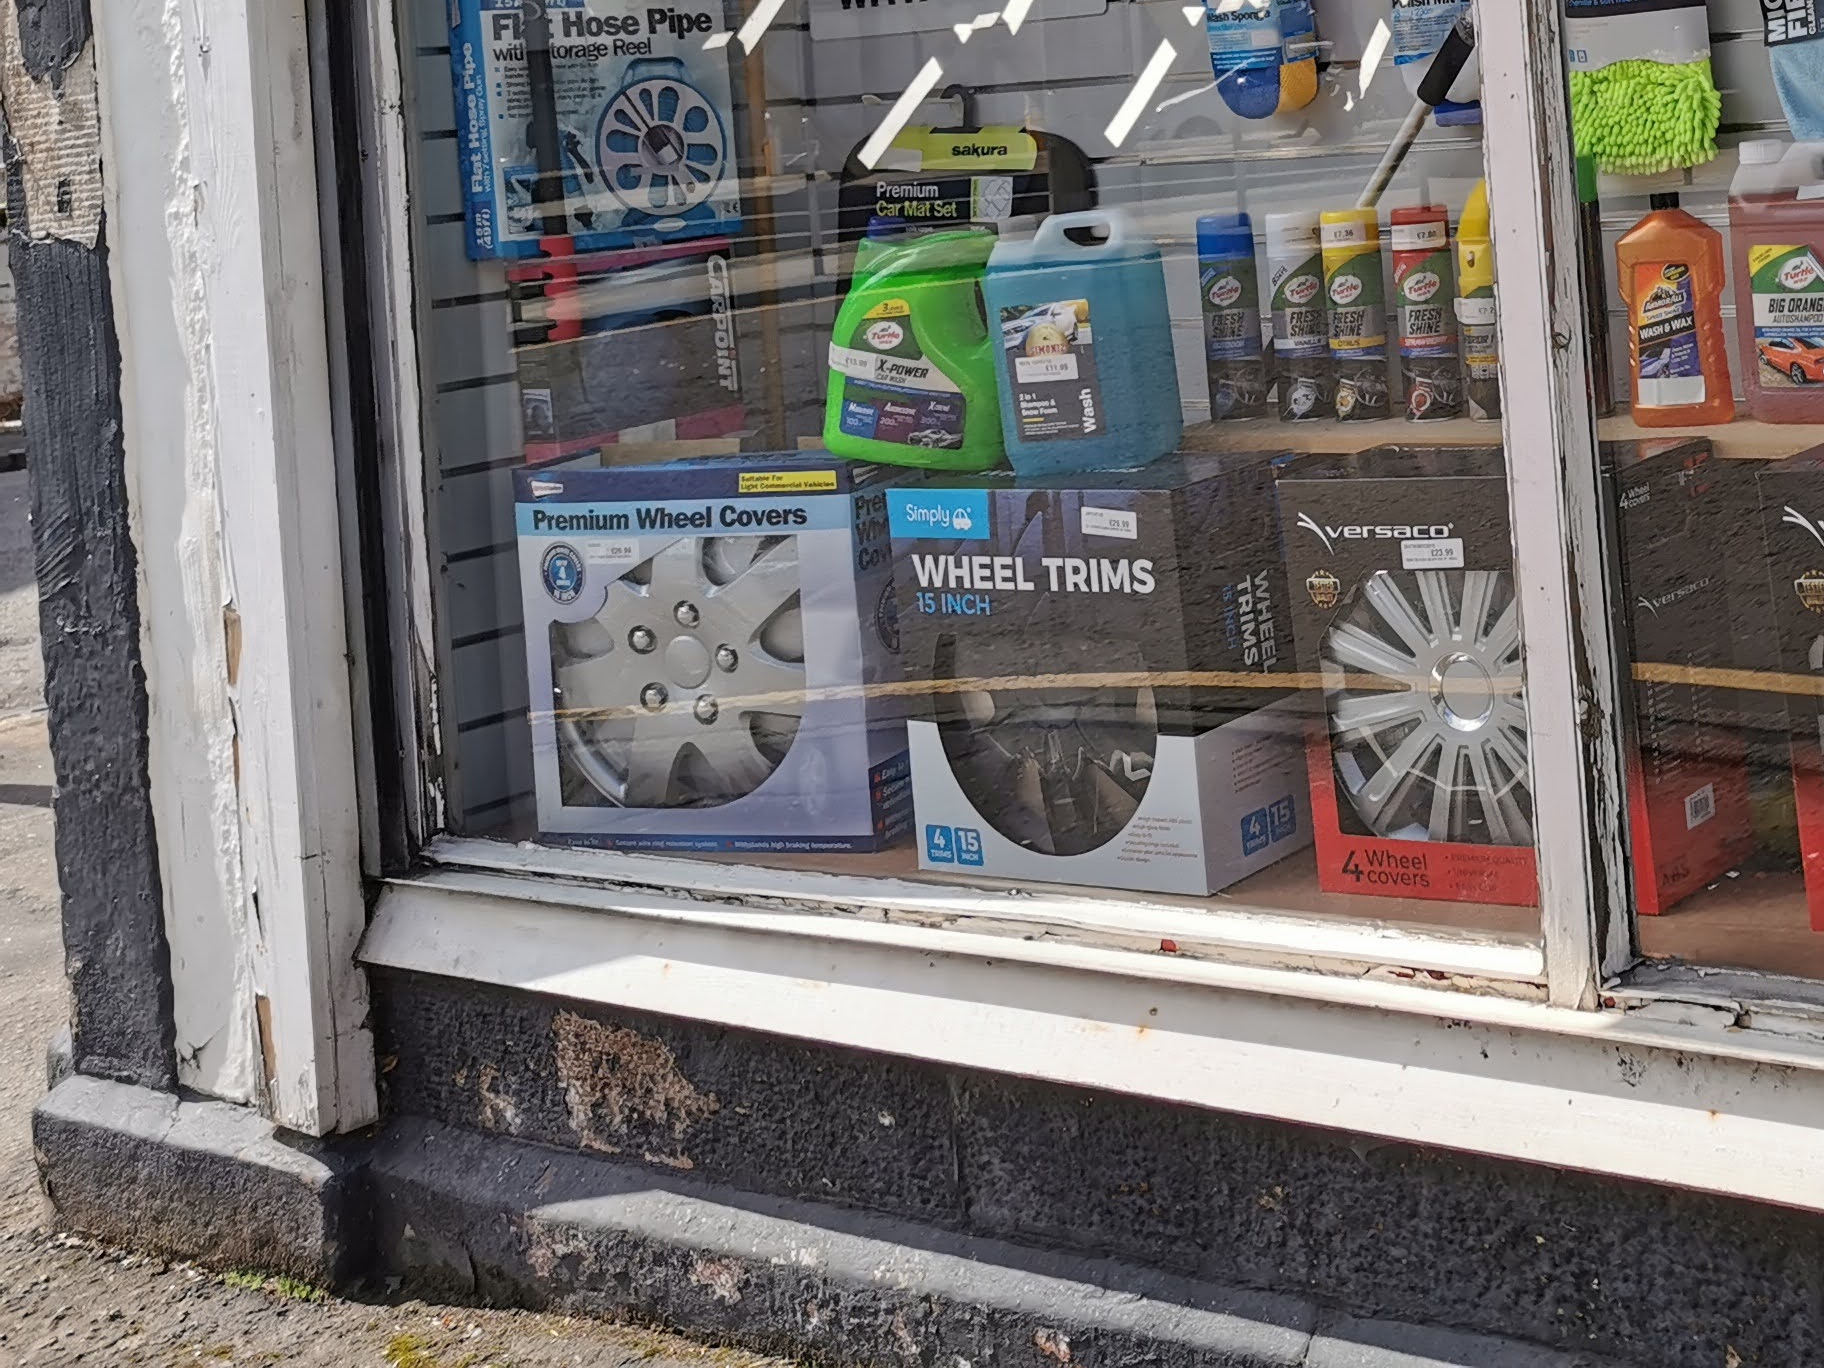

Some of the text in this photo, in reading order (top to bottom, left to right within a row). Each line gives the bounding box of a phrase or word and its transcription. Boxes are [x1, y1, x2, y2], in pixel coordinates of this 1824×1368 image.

[561, 7, 713, 40] Hose Pipe
[550, 37, 653, 62] torage Reel
[951, 142, 1008, 158] sakura
[876, 181, 939, 199] Premium
[876, 199, 958, 218] Car Set
[1408, 308, 1442, 323] FRESH
[1768, 298, 1785, 314] BIG
[704, 252, 738, 392] CARPOINT
[1408, 321, 1441, 336] SHINE
[1640, 316, 1693, 340] WASH WAX
[1030, 343, 1068, 355] SIMONIZ
[875, 359, 930, 379] X-POWER
[1079, 387, 1097, 434] Wash
[532, 503, 808, 531] Premium Wheel Covers
[905, 502, 950, 527] Simply
[1325, 523, 1450, 539] versaco
[911, 553, 1157, 594] WHEEL TRIMS
[916, 591, 991, 616] 15 INCH
[1233, 574, 1260, 666] TRIMS
[1251, 567, 1280, 674] WHEEL
[931, 829, 946, 849] 4
[958, 829, 978, 851] 15
[1341, 849, 1364, 883] 4
[1364, 848, 1429, 872] Wheel
[1366, 868, 1430, 889] covers
